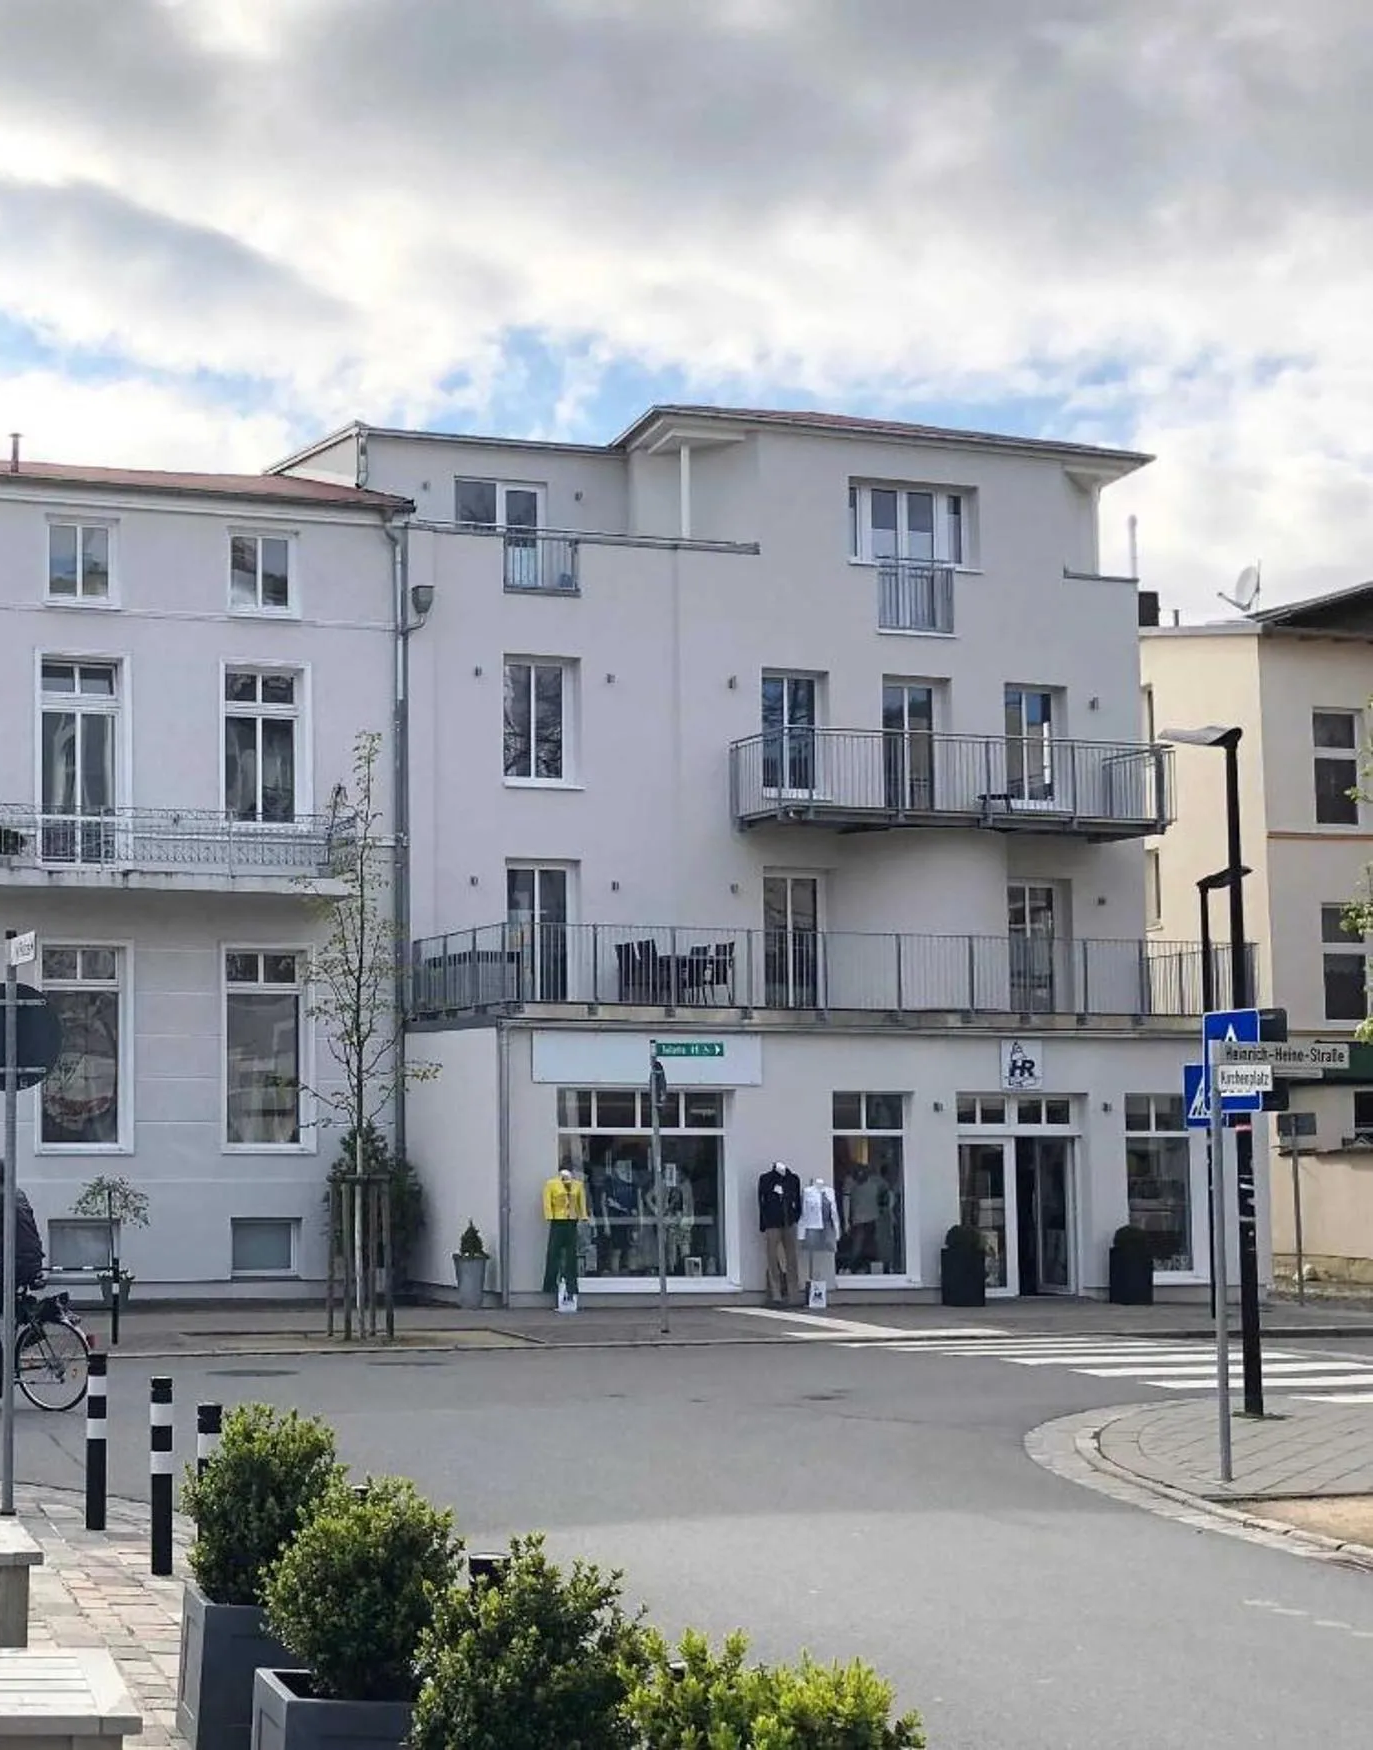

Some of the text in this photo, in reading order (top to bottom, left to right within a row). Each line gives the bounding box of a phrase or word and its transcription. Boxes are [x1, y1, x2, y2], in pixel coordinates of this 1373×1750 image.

[1226, 1045, 1345, 1063] Heinrich-Heine-Straße
[1009, 1059, 1035, 1077] HR
[1221, 1070, 1269, 1086] Kirchenplatz
